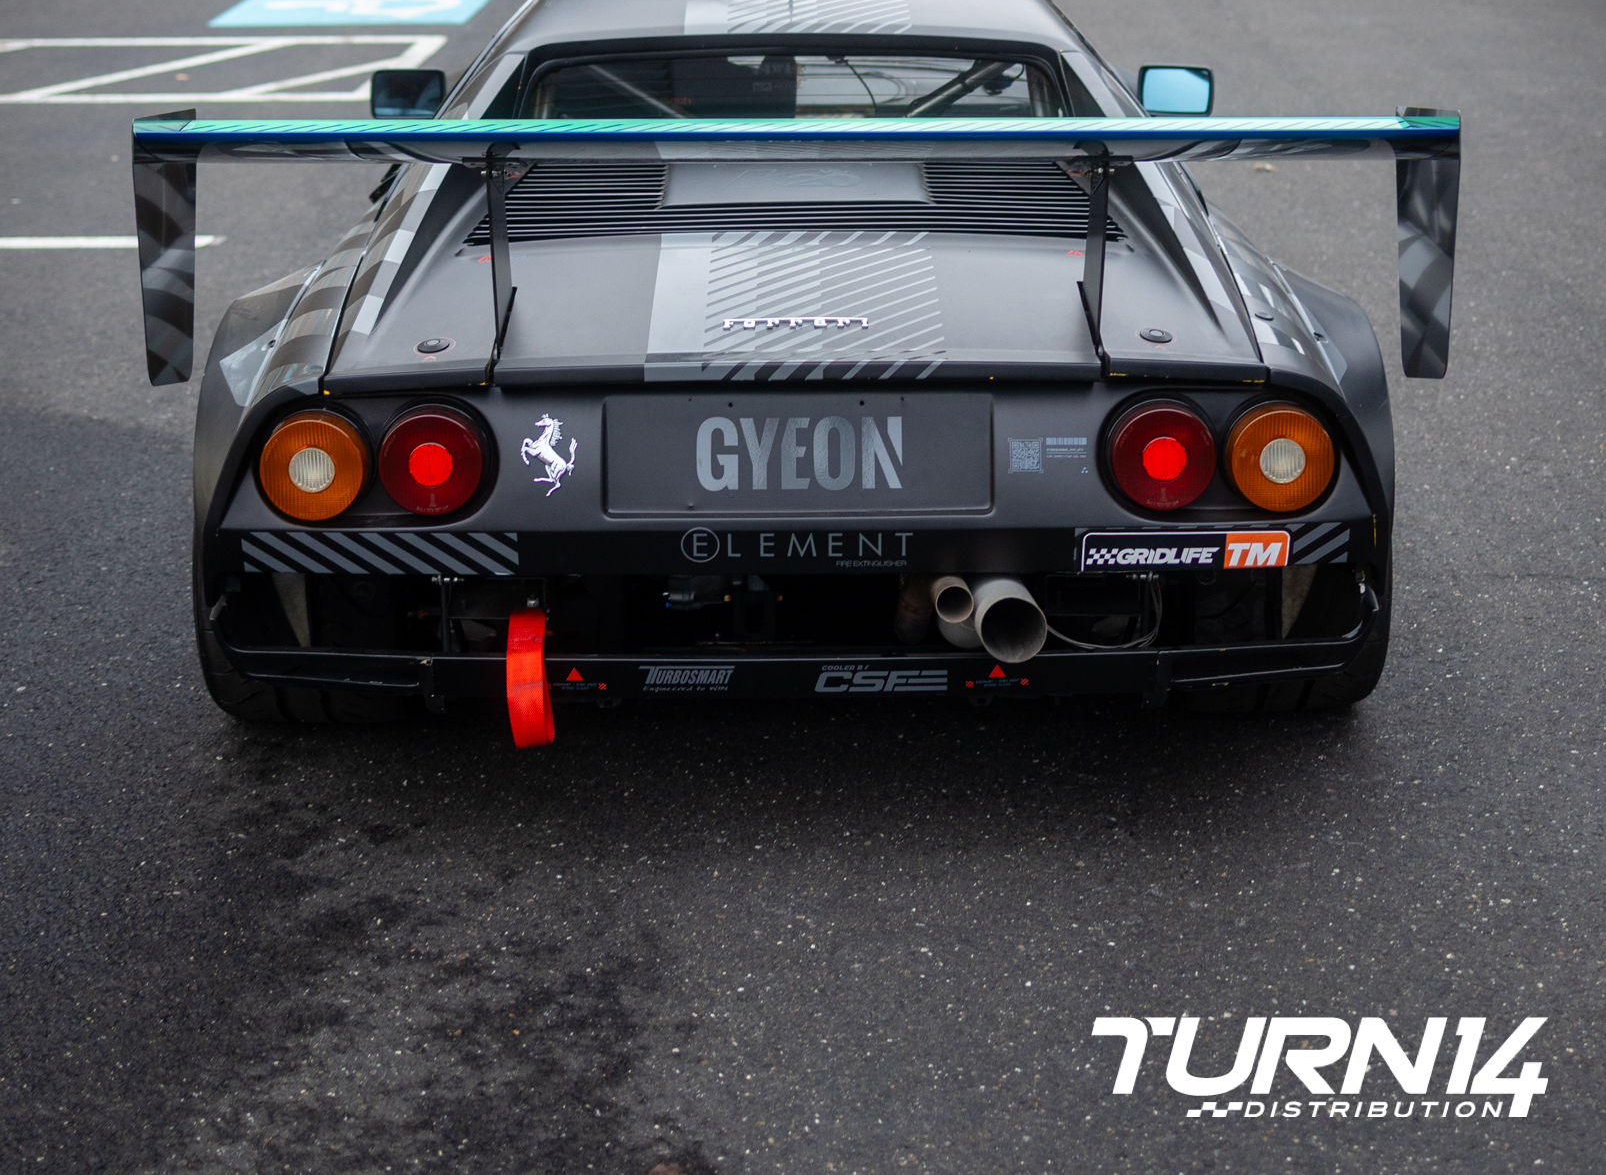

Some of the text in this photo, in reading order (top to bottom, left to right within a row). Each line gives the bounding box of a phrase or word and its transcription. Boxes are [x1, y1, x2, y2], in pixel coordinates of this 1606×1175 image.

[696, 415, 903, 492] GYEON
[681, 527, 913, 563] ELEMENT
[1116, 542, 1283, 567] GRIDLIFE TM
[639, 666, 735, 684] TURBOSMART
[814, 670, 948, 693] CSF
